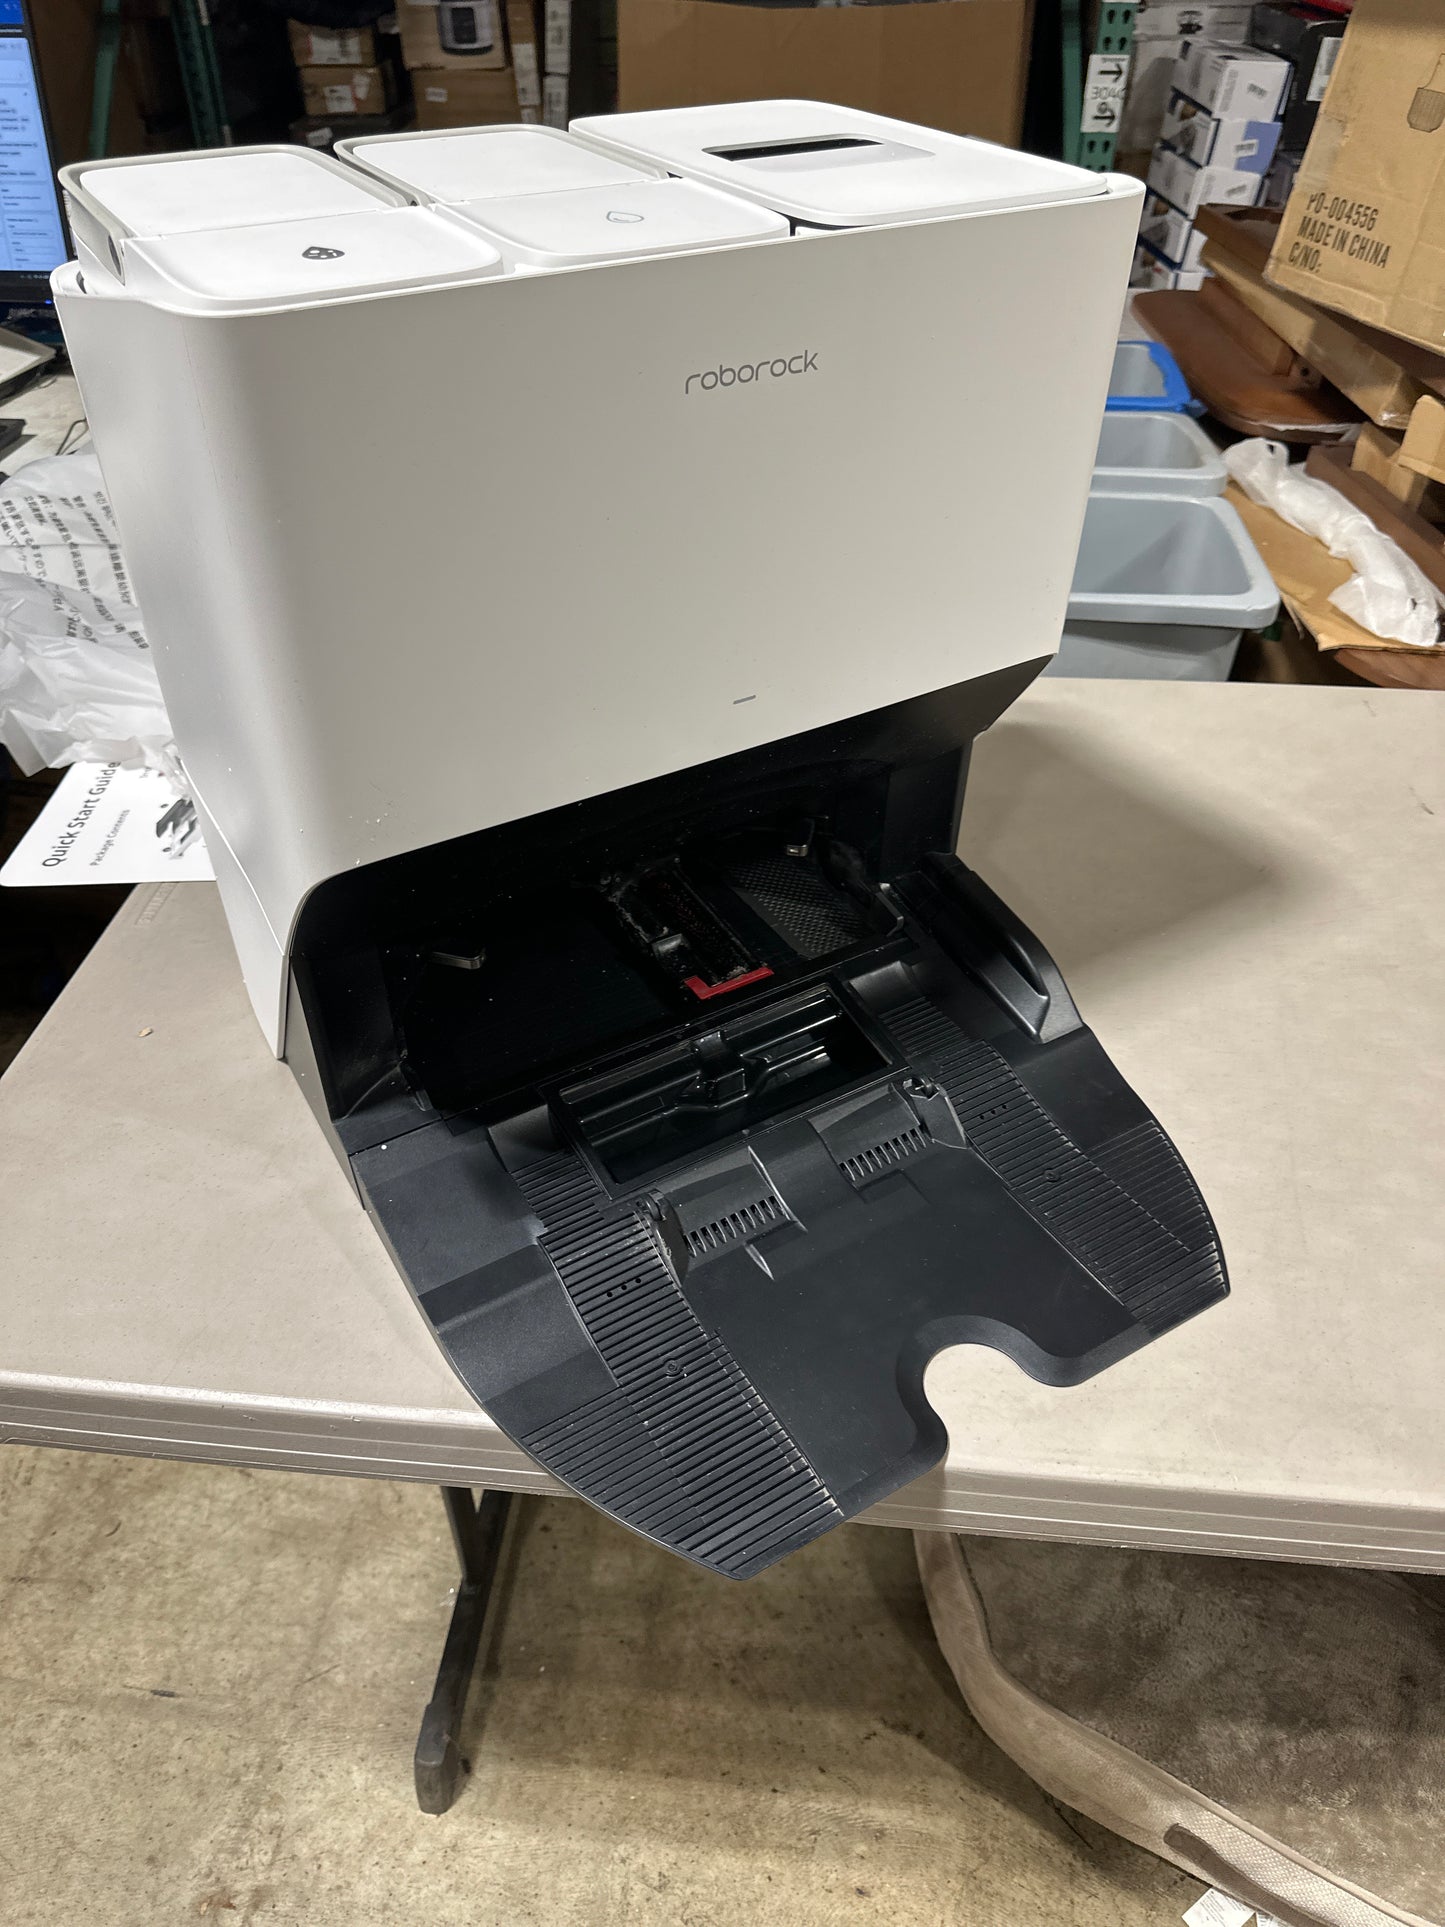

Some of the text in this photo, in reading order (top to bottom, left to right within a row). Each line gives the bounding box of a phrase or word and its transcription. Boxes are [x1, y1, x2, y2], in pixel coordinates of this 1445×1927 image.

[1297, 215, 1391, 269] MADE IN CHINA
[685, 349, 818, 394] roborock
[42, 761, 121, 867] Quick Start Guide
[89, 809, 131, 867] Package Contents
